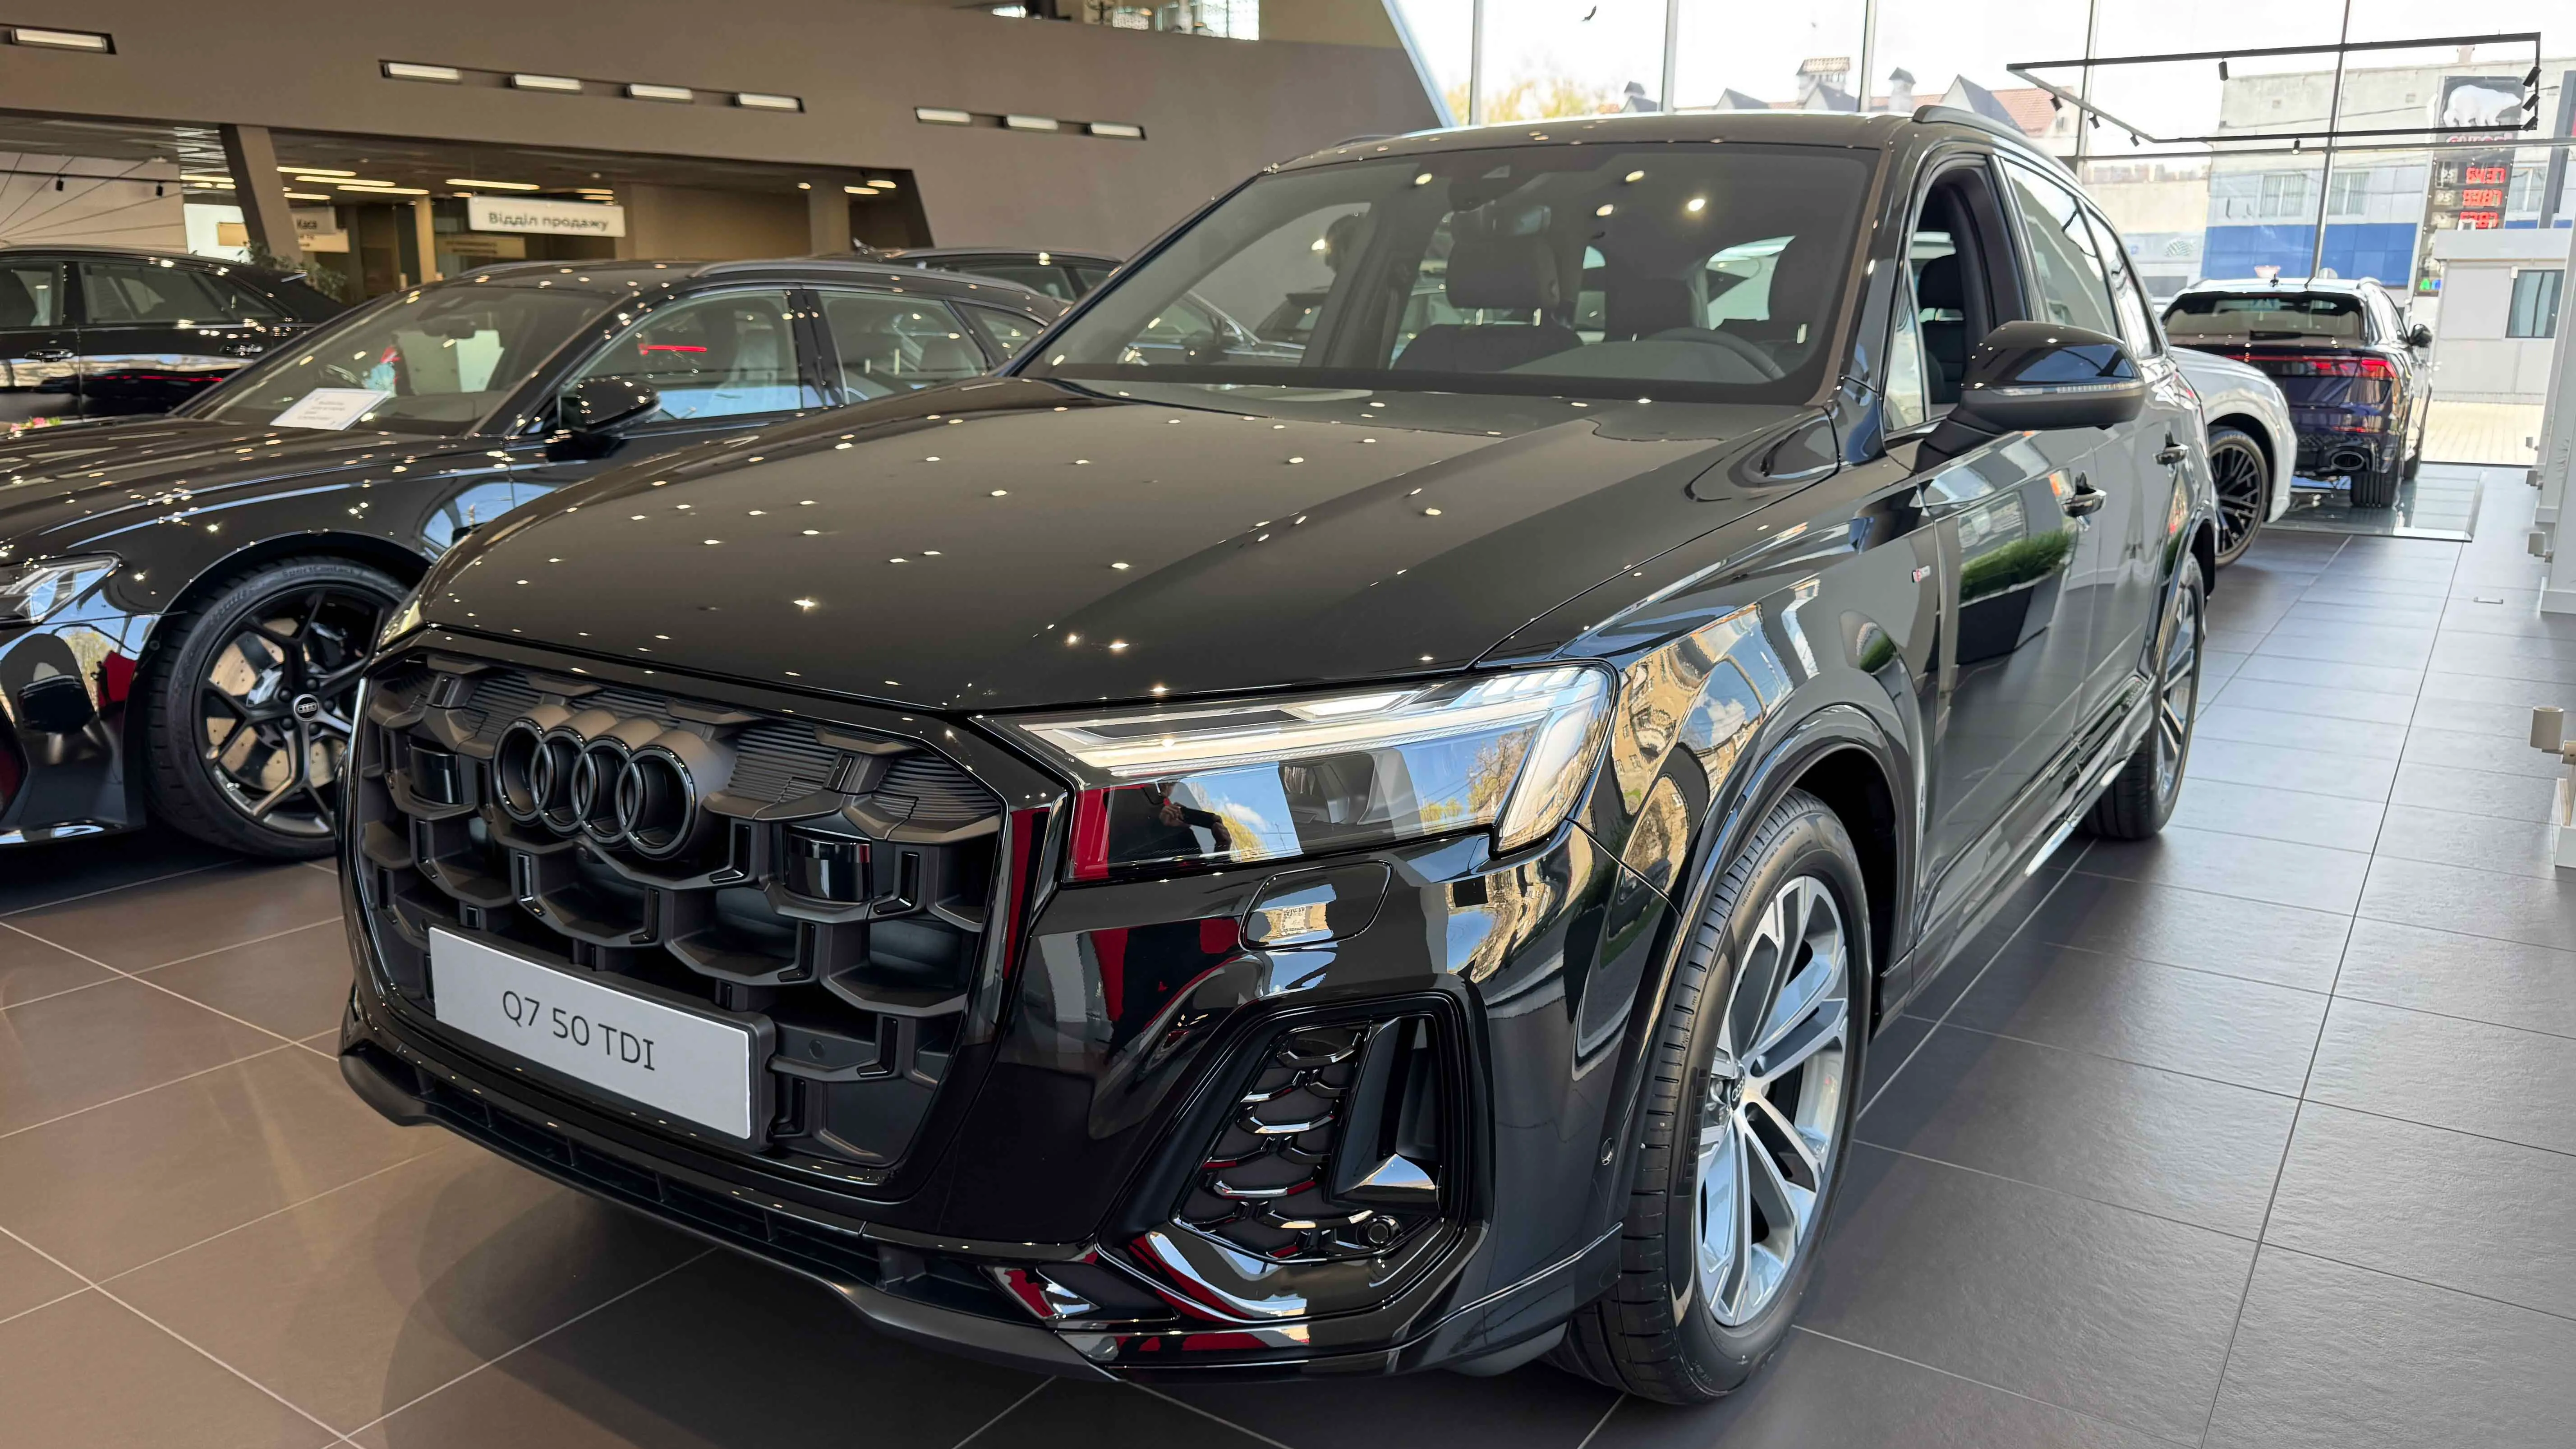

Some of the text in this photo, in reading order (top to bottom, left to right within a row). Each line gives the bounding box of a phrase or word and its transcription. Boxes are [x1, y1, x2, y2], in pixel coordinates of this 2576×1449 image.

[488, 212, 608, 231] Відділ продажу
[503, 991, 655, 1071] Q7 50 TDI
